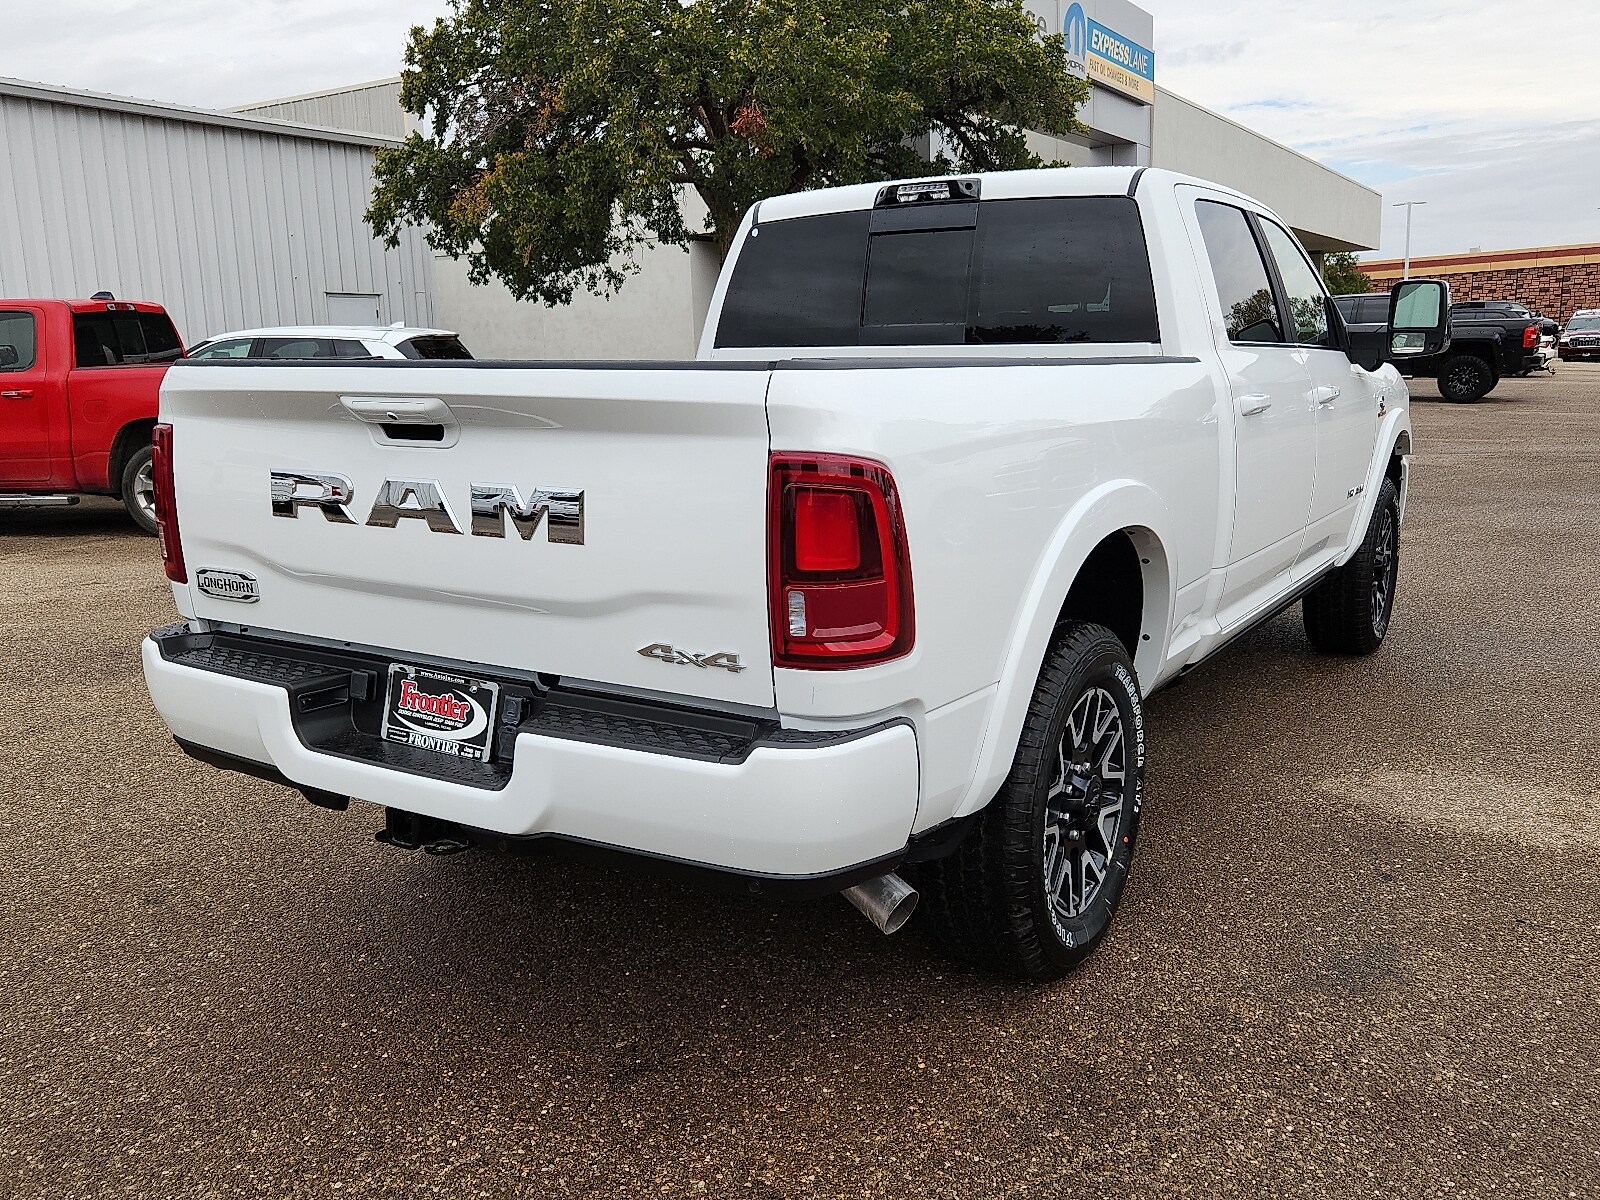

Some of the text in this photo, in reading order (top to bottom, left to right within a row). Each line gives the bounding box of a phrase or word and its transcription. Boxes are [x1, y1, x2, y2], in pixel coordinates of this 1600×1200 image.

[1089, 58, 1099, 73] FAST
[1128, 77, 1139, 91] MORE
[269, 468, 586, 546] RAM
[399, 680, 470, 722] Frontier
[408, 732, 460, 756] FRONTIER
